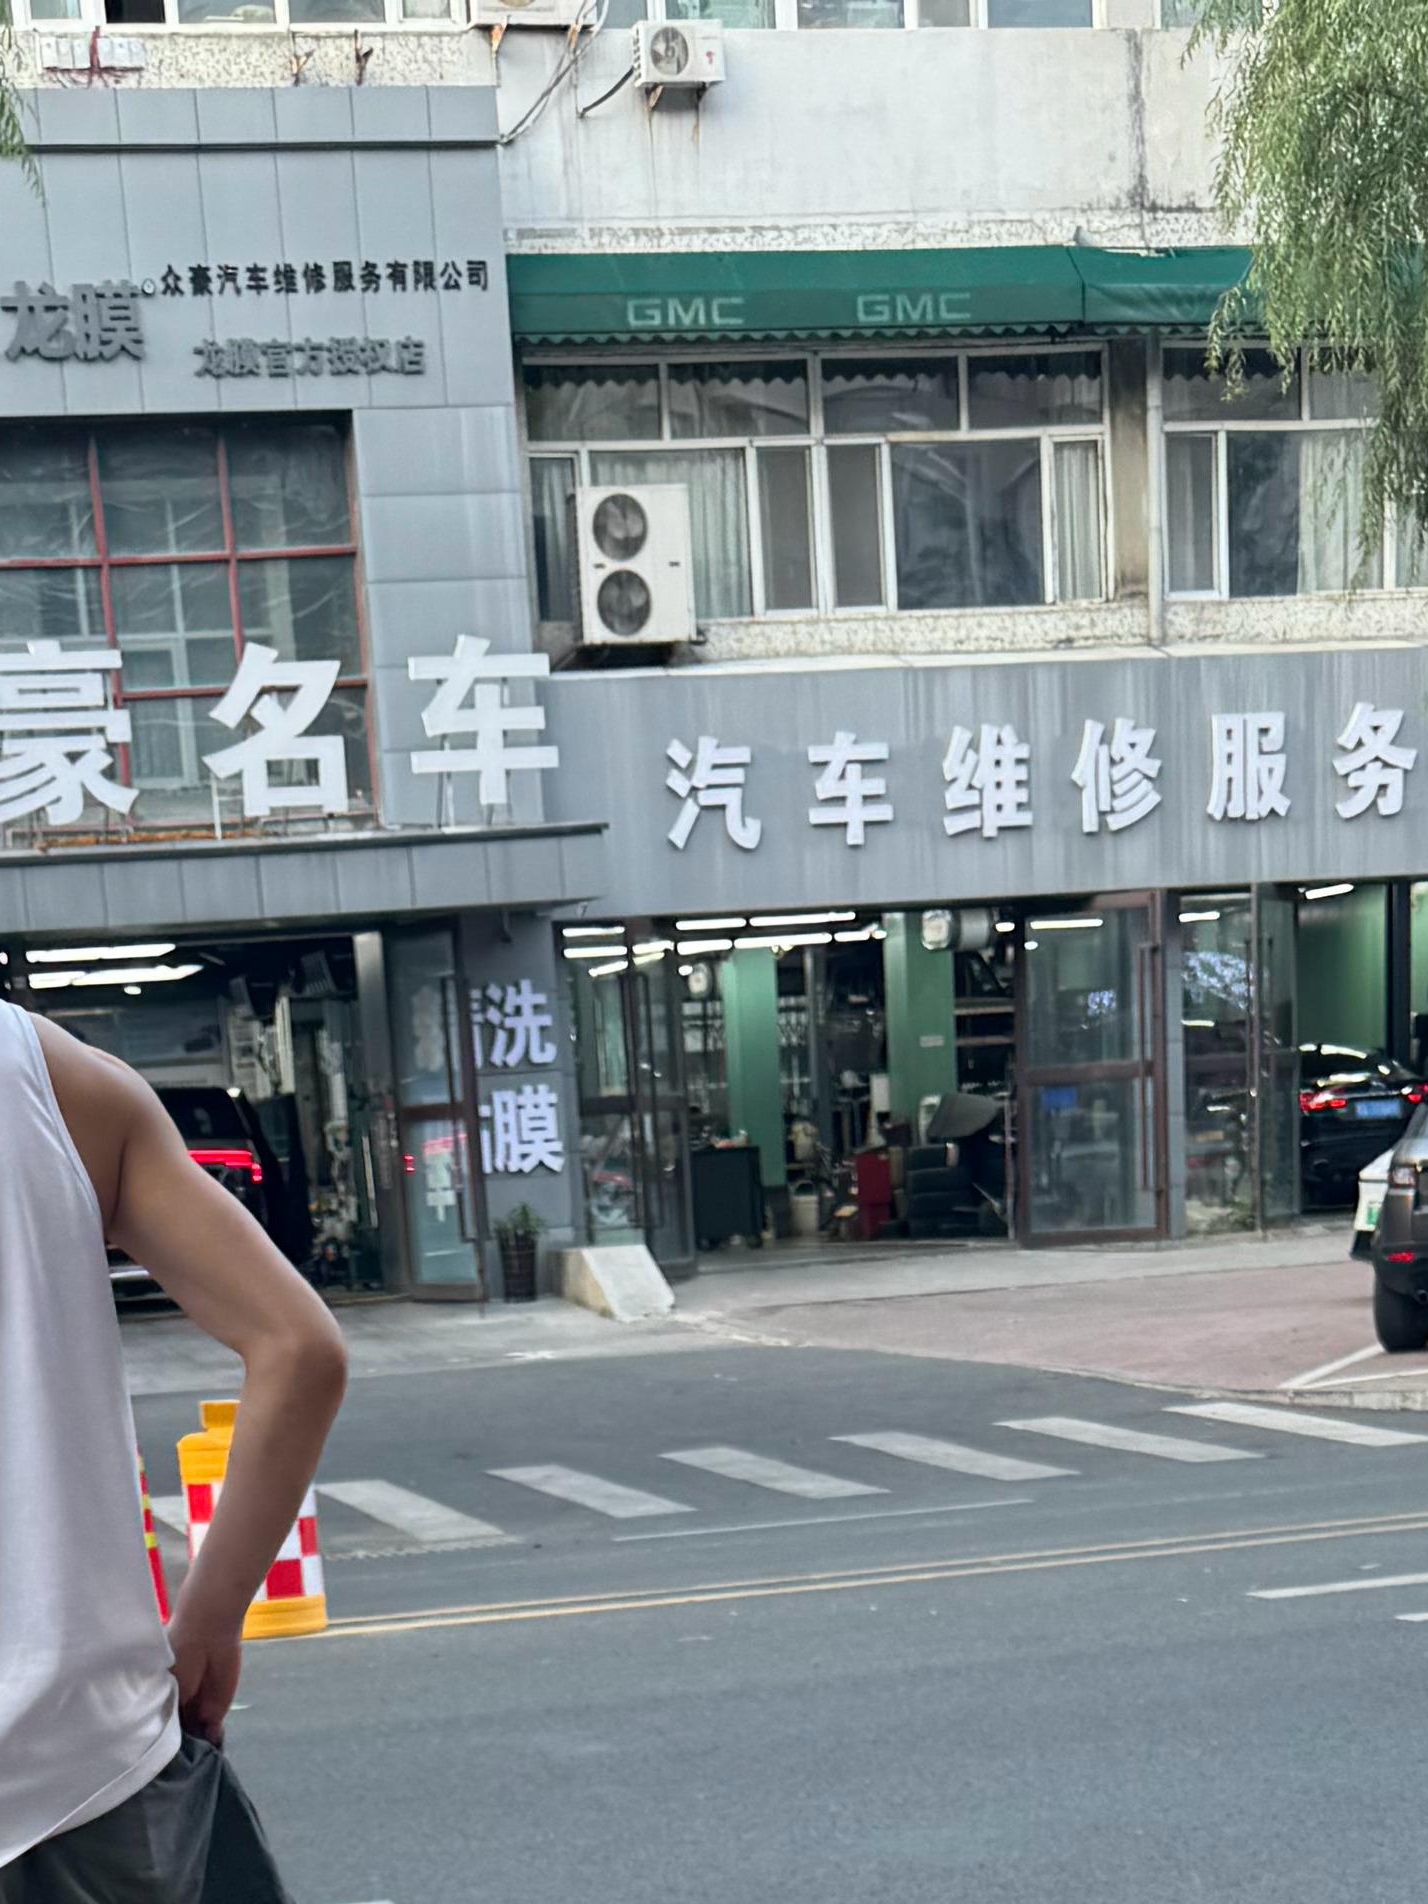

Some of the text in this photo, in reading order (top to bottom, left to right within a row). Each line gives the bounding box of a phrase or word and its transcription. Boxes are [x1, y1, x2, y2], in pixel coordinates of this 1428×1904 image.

[160, 261, 489, 297] 众豪汽车维修服务有限公司
[0, 279, 147, 362] 龙膜
[626, 291, 971, 328] GMC GMC
[486, 979, 564, 1174] 洗膜
